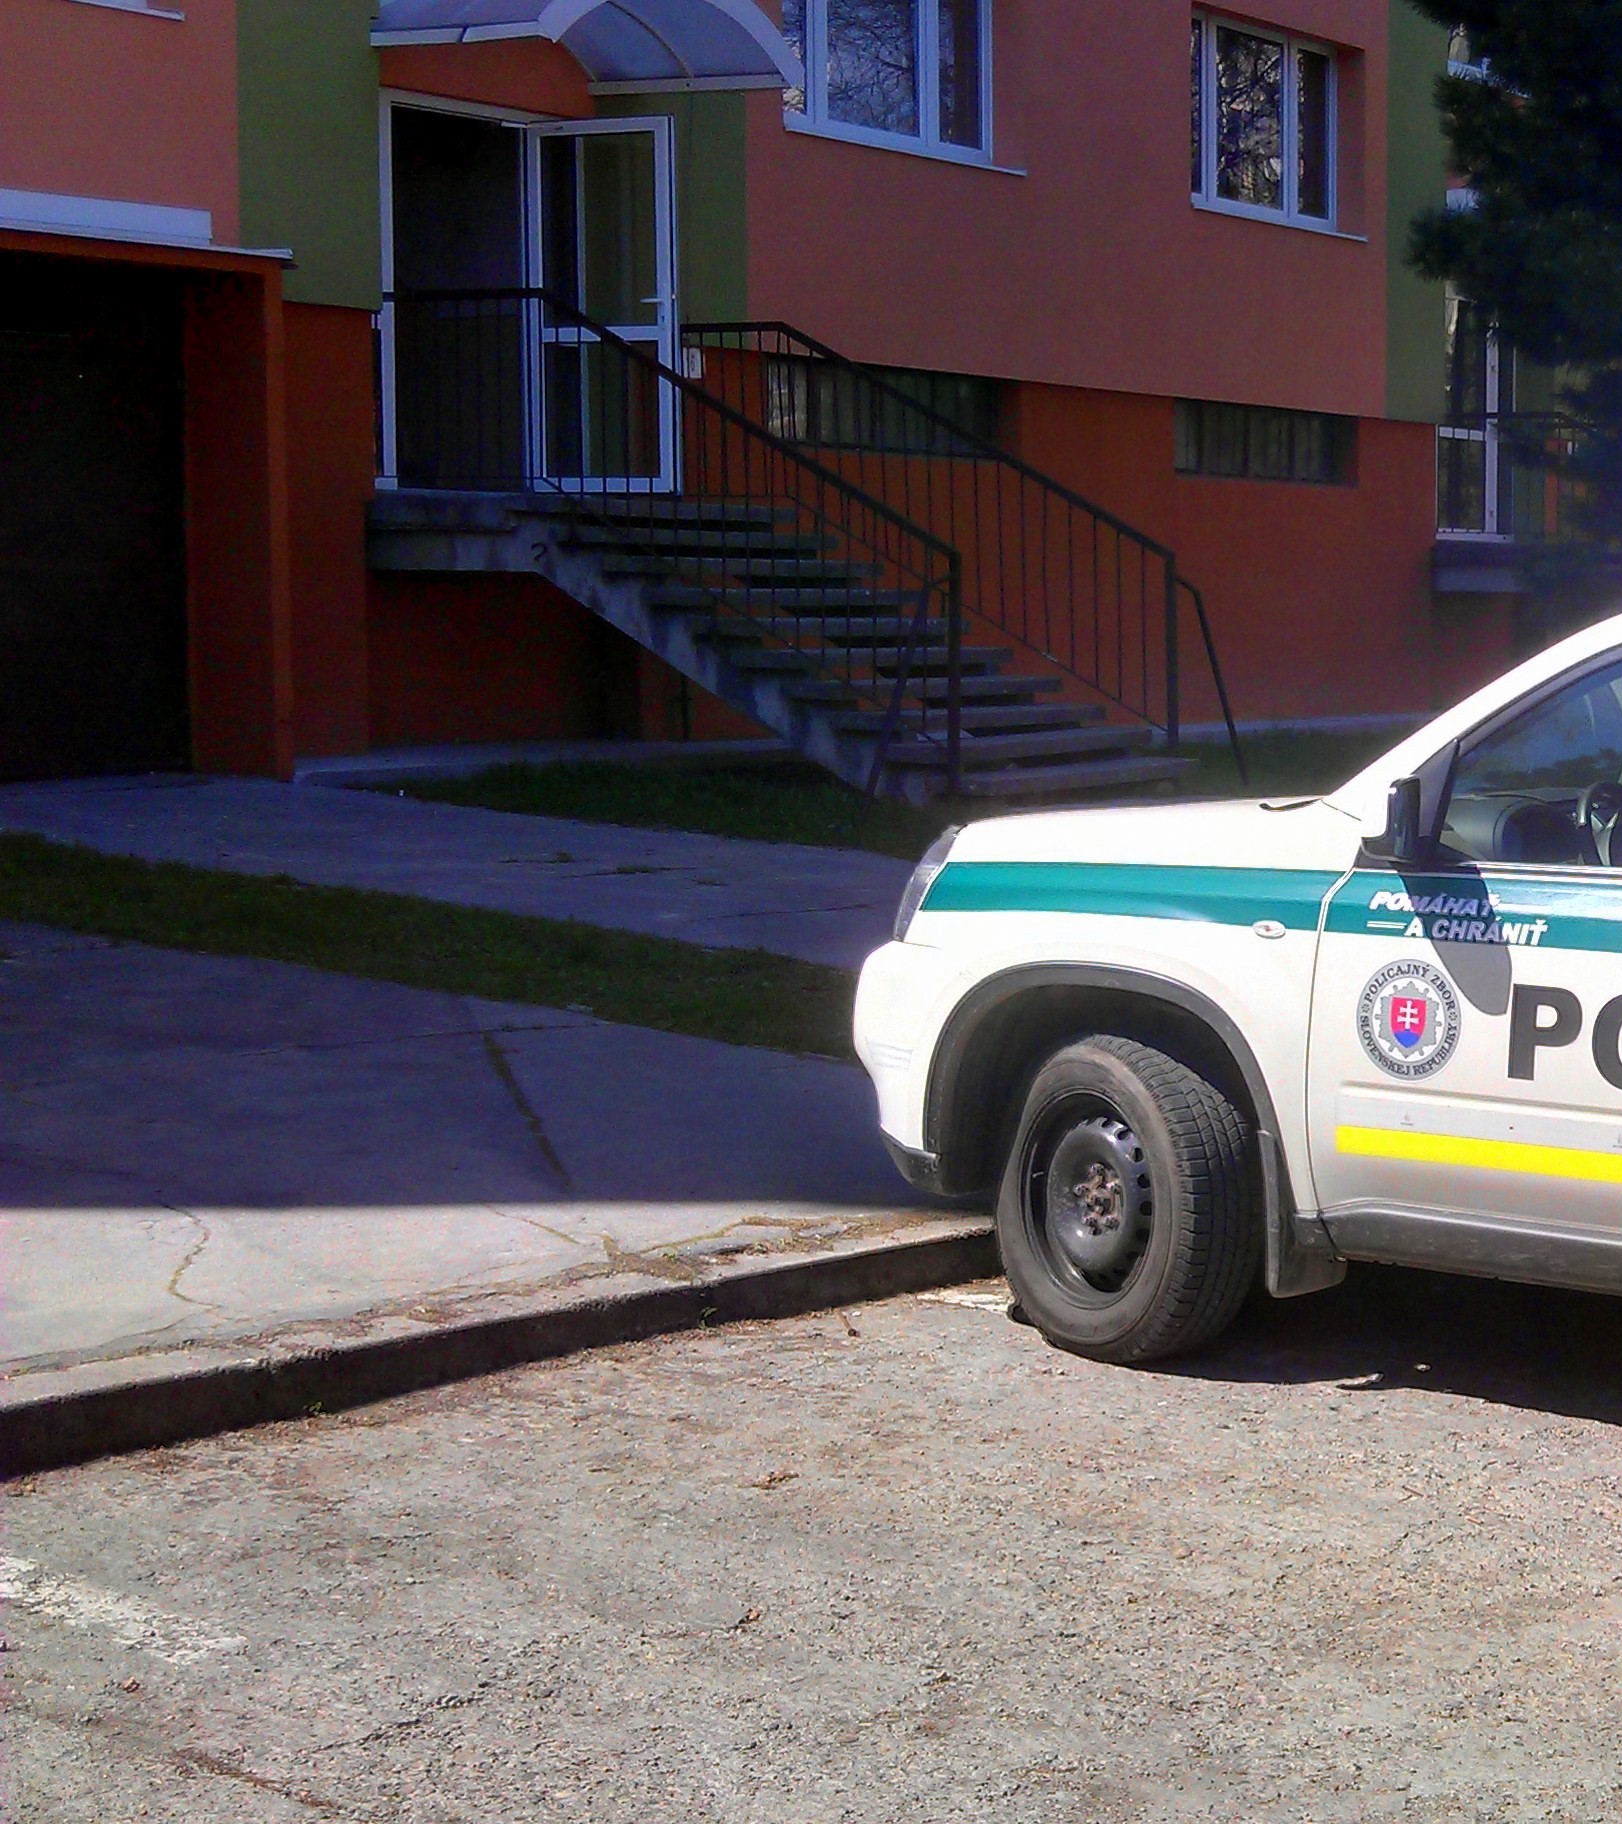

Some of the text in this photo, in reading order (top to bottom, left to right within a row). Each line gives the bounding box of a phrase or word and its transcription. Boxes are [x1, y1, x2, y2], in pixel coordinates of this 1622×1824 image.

[1404, 916, 1425, 938] A
[1429, 974, 1457, 1012] ZBOR
[1360, 1015, 1458, 1076] SLOVENSKEJ REPUBLIKY
